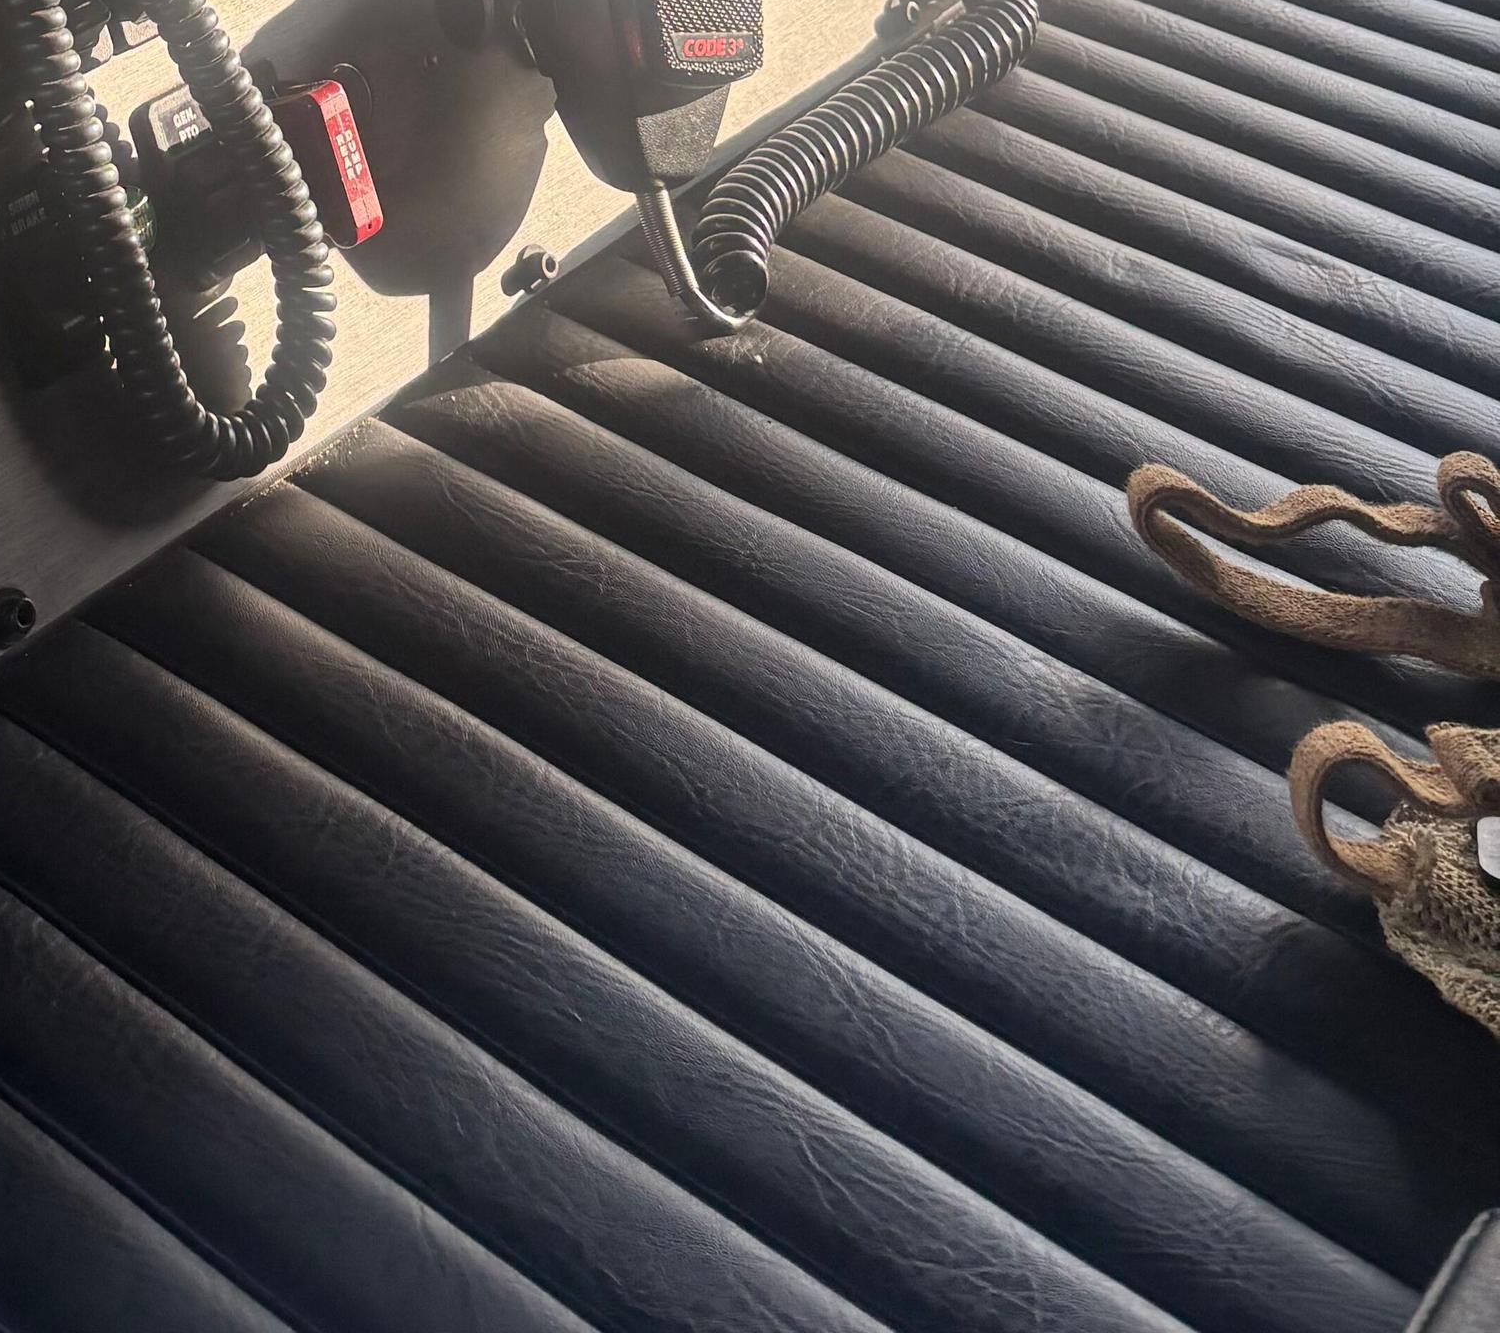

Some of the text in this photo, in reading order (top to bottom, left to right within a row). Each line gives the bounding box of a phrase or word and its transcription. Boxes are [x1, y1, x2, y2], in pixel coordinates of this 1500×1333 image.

[683, 37, 726, 57] CODE
[172, 107, 197, 128] GEN.
[179, 123, 200, 143] PTO
[344, 129, 364, 176] PUMP
[11, 206, 47, 236] BRAKE
